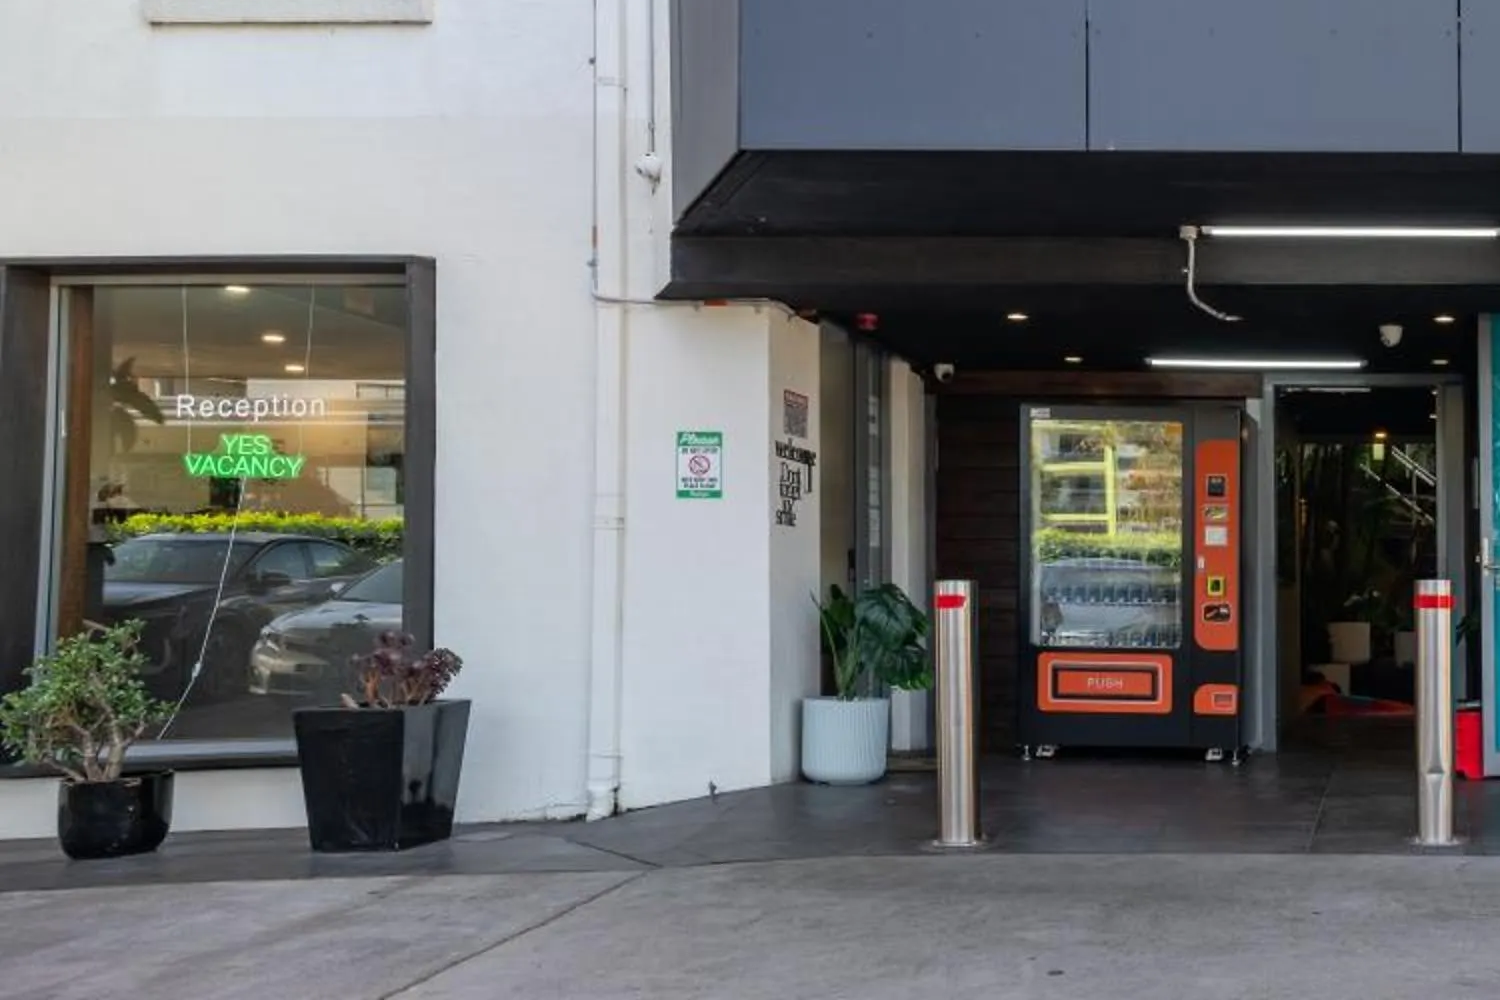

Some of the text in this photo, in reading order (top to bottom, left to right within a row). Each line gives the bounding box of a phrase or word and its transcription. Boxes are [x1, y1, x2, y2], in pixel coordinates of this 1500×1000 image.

[176, 394, 326, 422] Reception
[221, 433, 272, 455] YES
[185, 454, 305, 477] VACANCY
[1087, 677, 1123, 689] PUSH
